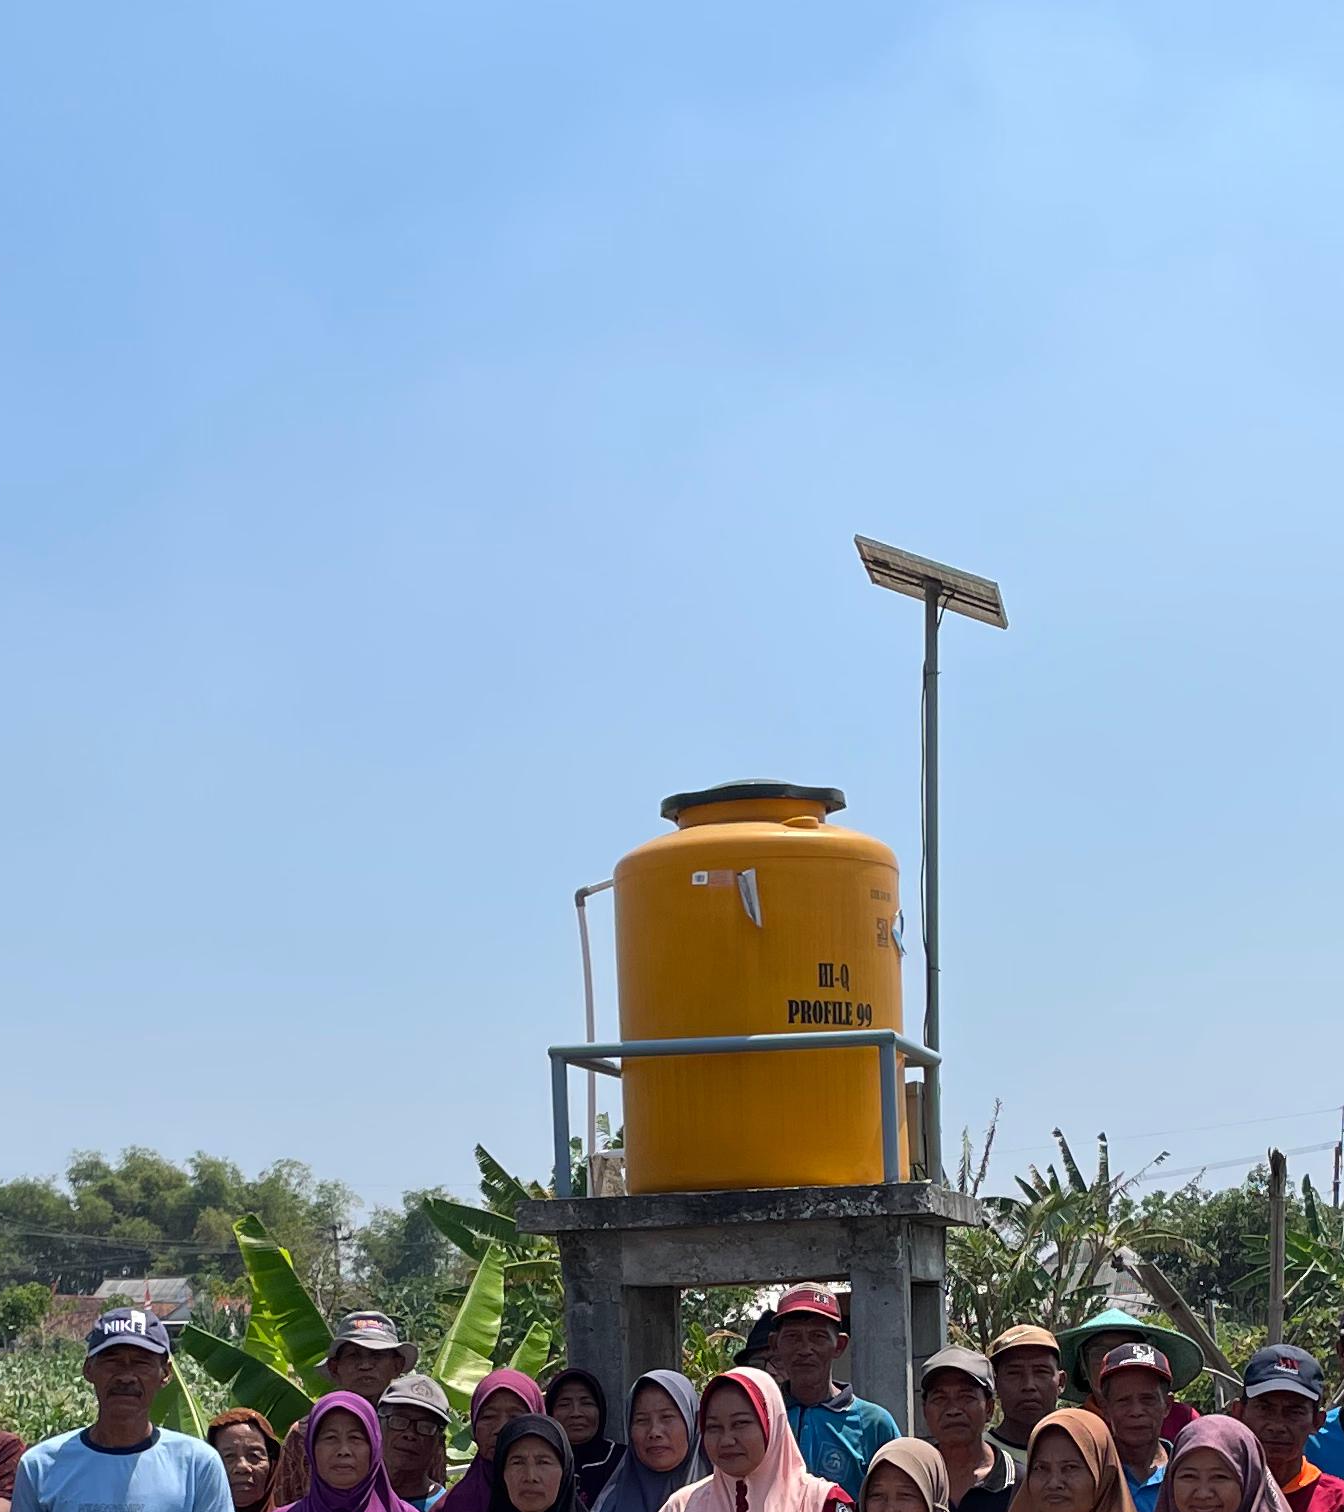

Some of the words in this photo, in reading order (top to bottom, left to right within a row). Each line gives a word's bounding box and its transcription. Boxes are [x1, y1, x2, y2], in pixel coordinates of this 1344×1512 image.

[818, 963, 850, 992] HI-Q
[787, 999, 853, 1026] PROFILE
[856, 1002, 873, 1028] 99
